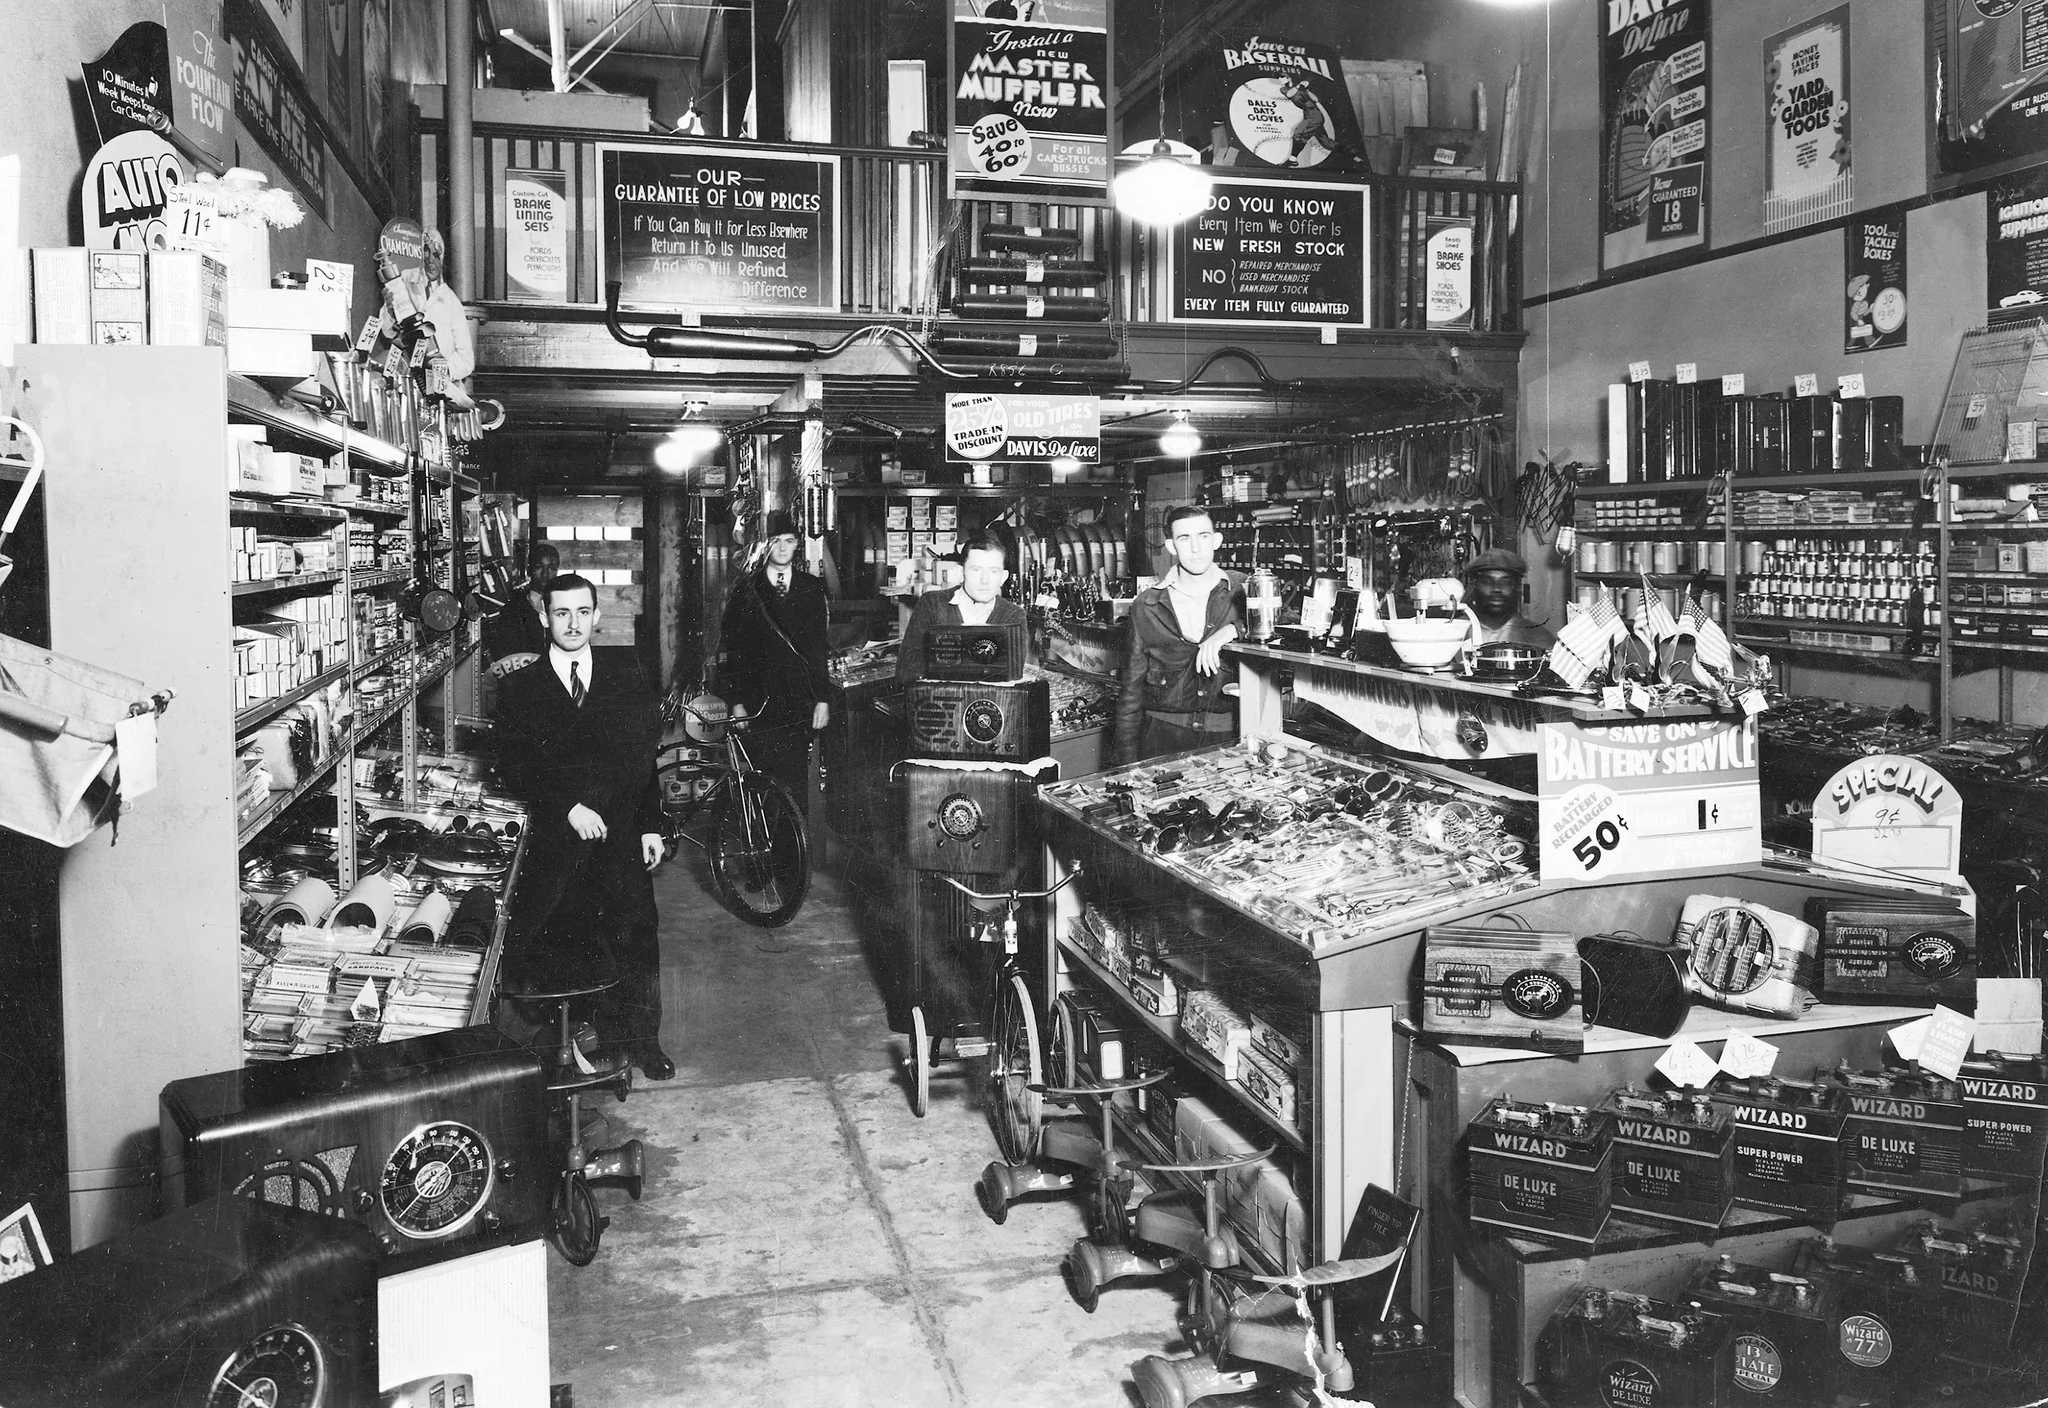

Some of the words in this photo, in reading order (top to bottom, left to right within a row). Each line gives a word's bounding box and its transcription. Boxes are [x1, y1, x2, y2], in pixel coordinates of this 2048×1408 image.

[986, 30, 1060, 52] Install
[1062, 32, 1074, 44] a
[1288, 46, 1306, 55] on
[1792, 43, 1819, 60] MONEY
[1792, 52, 1820, 70] SAVING
[968, 52, 1096, 82] MASTER
[1223, 48, 1334, 81] BASEBALL
[1258, 65, 1300, 76] SUPPLIES
[1793, 60, 1819, 77] PRICES
[102, 68, 114, 82] 10
[114, 73, 144, 96] Minutes
[176, 54, 231, 111] FOUNTAIN
[956, 71, 1106, 109] MUFFLER
[1788, 78, 1824, 105] YARD
[98, 81, 118, 100] Week
[120, 90, 141, 108] Keeps
[1248, 100, 1277, 108] BALLS
[110, 100, 125, 116] Car
[126, 106, 146, 124] Clean
[190, 92, 223, 134] FLOW
[230, 32, 272, 118] FAN
[280, 100, 320, 179] BELT
[1012, 100, 1058, 118] Now
[1254, 107, 1276, 115] BATS
[1782, 90, 1834, 124] GARDEN
[1248, 114, 1284, 123] GLOVES
[1784, 109, 1830, 140] TOOLS
[972, 118, 1018, 144] Save
[978, 140, 1012, 158] 40
[1014, 138, 1025, 148] to
[1052, 144, 1074, 154] For
[1077, 144, 1090, 154] all
[986, 152, 1028, 173] 60%
[1036, 154, 1107, 166] CARS-TRUCKS
[1053, 164, 1090, 174] BUSSES
[696, 168, 742, 186] OUR
[98, 153, 184, 222] AUTO
[170, 186, 192, 204] Steel
[196, 196, 215, 208] Wool
[614, 182, 700, 204] GUARANTEE
[706, 188, 727, 206] OF
[734, 190, 764, 208] LOW
[770, 192, 820, 212] PRICES
[1652, 186, 1698, 204] GUARANTEED
[514, 198, 551, 210] BRAKE
[1239, 196, 1274, 213] YOU
[1284, 198, 1334, 216] KNOW
[1664, 200, 1681, 223] 18
[182, 208, 211, 236] 11¢
[516, 210, 554, 221] LINING
[524, 222, 549, 232] SETS
[634, 215, 644, 231] If
[647, 216, 664, 232] You
[669, 216, 689, 234] Can
[694, 220, 710, 238] Buy
[715, 220, 722, 236] It
[728, 220, 743, 236] For
[746, 221, 766, 237] Less
[770, 222, 808, 240] Elsewhere
[1200, 216, 1228, 236] Every
[1235, 216, 1263, 236] Item
[1268, 218, 1284, 234] We
[1290, 219, 1326, 236] Offer
[1332, 222, 1342, 236] Is
[1662, 222, 1682, 232] MONTHS
[1864, 224, 1888, 237] TOOL
[380, 236, 422, 259] CHAMPIONS
[652, 237, 686, 254] Return
[690, 240, 700, 254] It
[704, 240, 716, 256] To
[721, 242, 734, 256] Us
[742, 242, 786, 260] Unused
[1193, 238, 1224, 252] NEW
[1240, 240, 1282, 254] FRESH
[1295, 242, 1345, 256] STOCK
[1864, 236, 1897, 249] TACKLE
[524, 255, 560, 263] CHEVROLETS
[1436, 251, 1464, 261] BRAKE
[1864, 247, 1892, 260] BOXES
[652, 258, 678, 274] And
[687, 260, 704, 274] We
[710, 260, 730, 276] Will
[738, 261, 788, 278] Refund
[1240, 260, 1272, 270] REPAIRED
[1274, 262, 1322, 272] MERCHANDISE
[1436, 261, 1462, 270] SHOES
[1202, 269, 1226, 284] NO
[1240, 272, 1258, 281] USED
[1260, 273, 1311, 283] MERCHANDISE
[1239, 284, 1278, 294] BANKRUPT
[1282, 285, 1308, 294] STOCK
[1184, 298, 1217, 311] EVERY
[1224, 300, 1250, 312] ITEM
[1256, 300, 1285, 312] FULLY
[1290, 302, 1350, 315] GUARANTEED
[952, 400, 970, 410] MORE
[972, 396, 993, 406] THAN
[950, 401, 1004, 432] 25%
[1013, 412, 1044, 428] OLD
[1046, 402, 1093, 426] TIRES
[954, 424, 1004, 441] TRADE-IN
[958, 434, 1003, 451] DISCOUNT
[1006, 440, 1048, 456] DAVIS
[1609, 724, 1660, 744] SAVE
[1665, 722, 1696, 742] ON
[1544, 726, 1658, 782] BATTERY
[1662, 716, 1756, 774] SERVICE
[1832, 761, 1943, 814] SPECIAL
[1554, 792, 1599, 834] BATTERY
[1562, 794, 1582, 812] ANY
[1552, 796, 1614, 850] RECHARGED
[1875, 808, 1900, 826] 9¢
[1572, 814, 1629, 871] 50¢
[1963, 1079, 2037, 1101] WIZARD
[1735, 1104, 1807, 1130] WIZARD
[1852, 1098, 1926, 1120] WIZARD
[1617, 1119, 1692, 1146] WIZARD
[1495, 1132, 1567, 1159] WIZARD
[1862, 1136, 1878, 1150] DE
[1882, 1138, 1916, 1154] LUXE
[1628, 1161, 1643, 1176] DE
[1648, 1165, 1680, 1183] LUXE
[1504, 1174, 1519, 1189] DE
[1524, 1178, 1557, 1196] LUXE
[1367, 1206, 1390, 1223] FINGER
[1392, 1218, 1402, 1229] TIP
[1372, 1222, 1388, 1236] FILE
[1942, 1266, 1998, 1292] IZARD
[1845, 1324, 1884, 1341] Wizard
[1736, 1338, 1772, 1354] WIZARD
[1747, 1345, 1760, 1358] 13
[1609, 1375, 1653, 1394] Wizard
[1612, 1388, 1625, 1399] DE
[1628, 1392, 1651, 1406] LUXE
